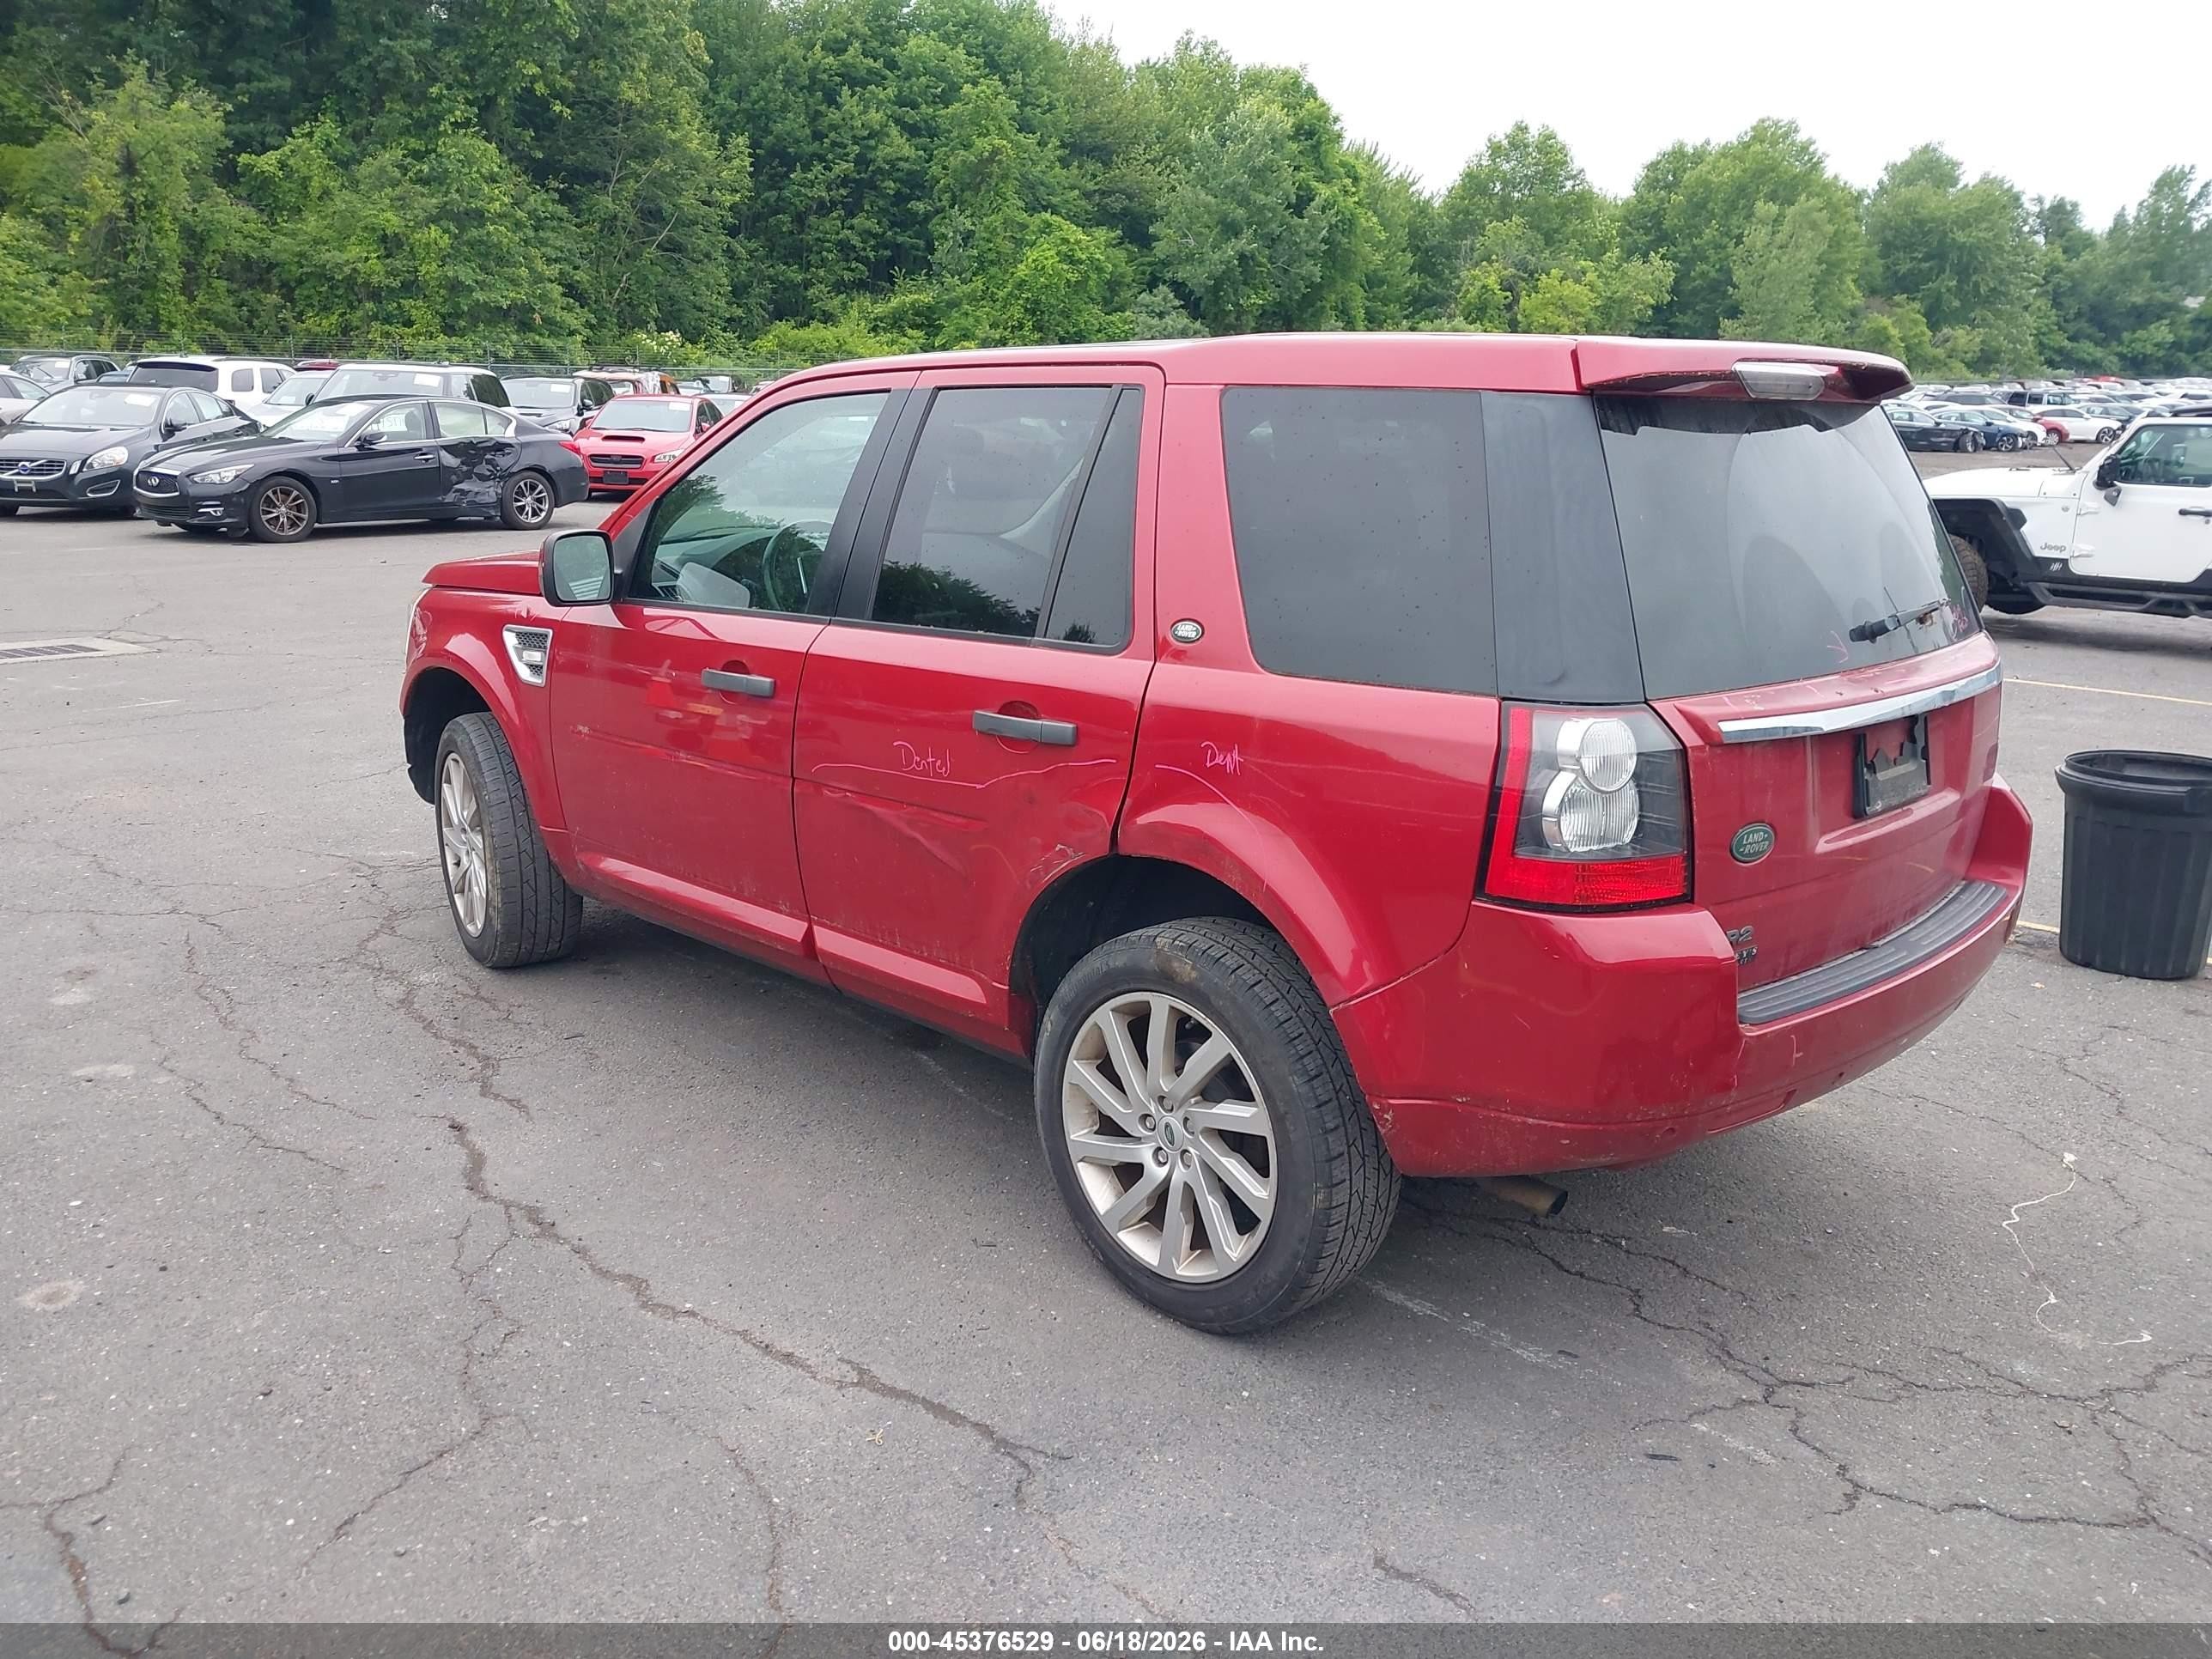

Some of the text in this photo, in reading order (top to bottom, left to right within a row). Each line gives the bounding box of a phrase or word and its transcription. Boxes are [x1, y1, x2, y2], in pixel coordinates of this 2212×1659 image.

[2039, 542, 2067, 553] Jeep
[1743, 831, 1765, 845] LAND
[1744, 841, 1771, 854] ROVER
